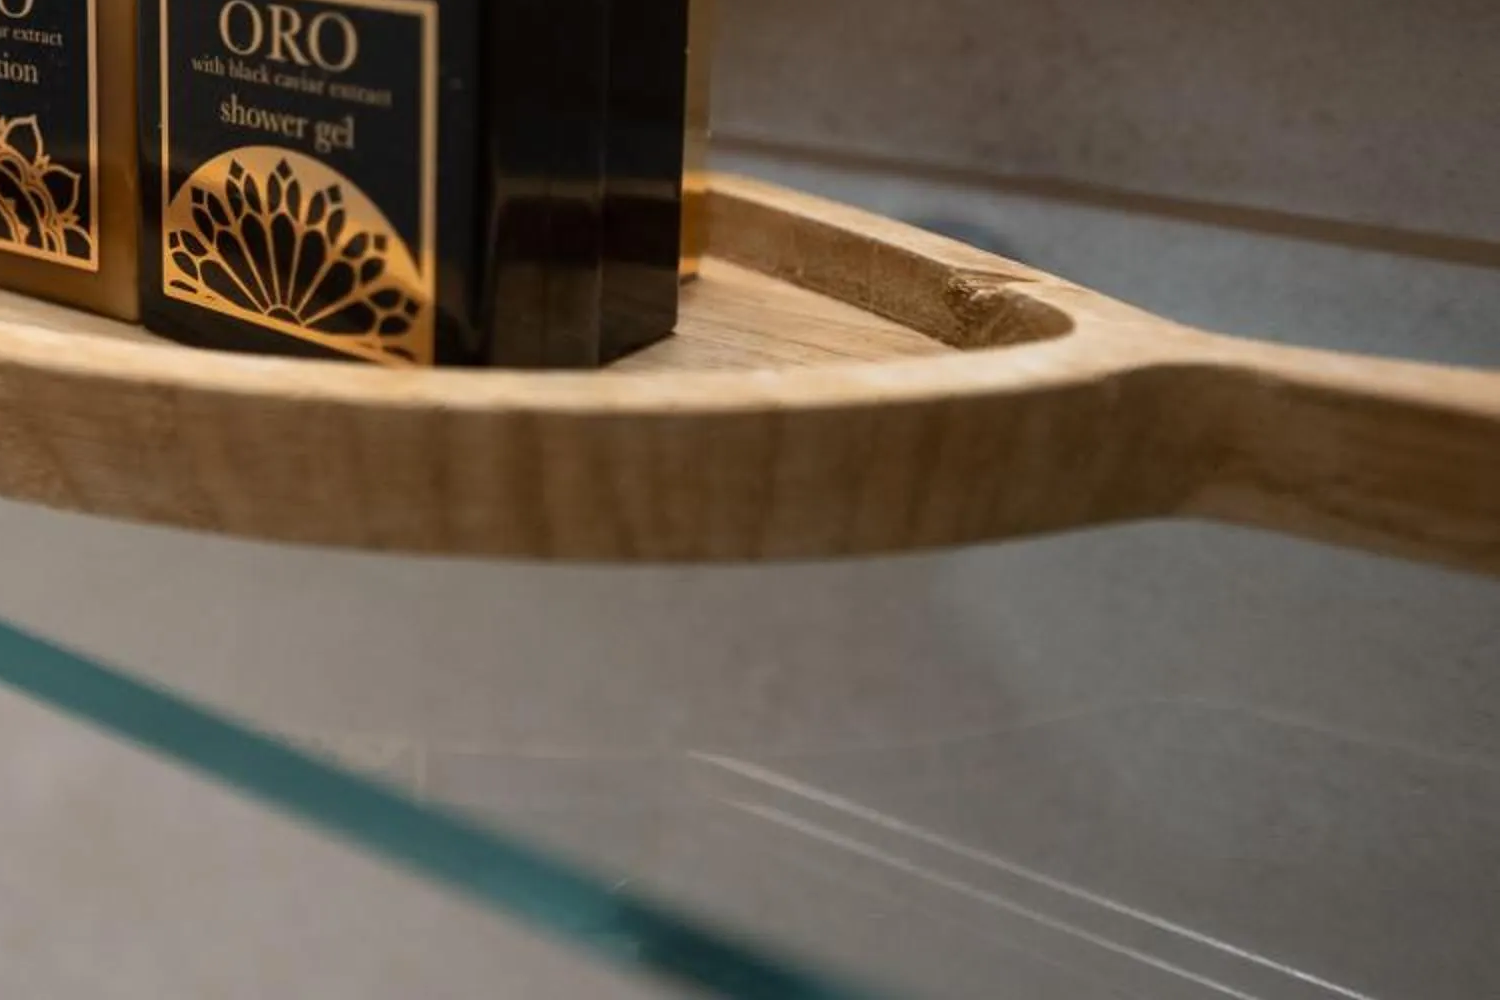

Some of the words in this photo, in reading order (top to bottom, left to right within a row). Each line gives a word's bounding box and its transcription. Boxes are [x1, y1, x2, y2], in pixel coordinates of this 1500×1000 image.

[13, 26, 63, 47] extract
[218, 0, 359, 72] ORO
[190, 55, 225, 77] with
[228, 60, 269, 84] black
[274, 70, 324, 94] caviar
[219, 94, 308, 138] shower
[314, 114, 354, 153] gel
